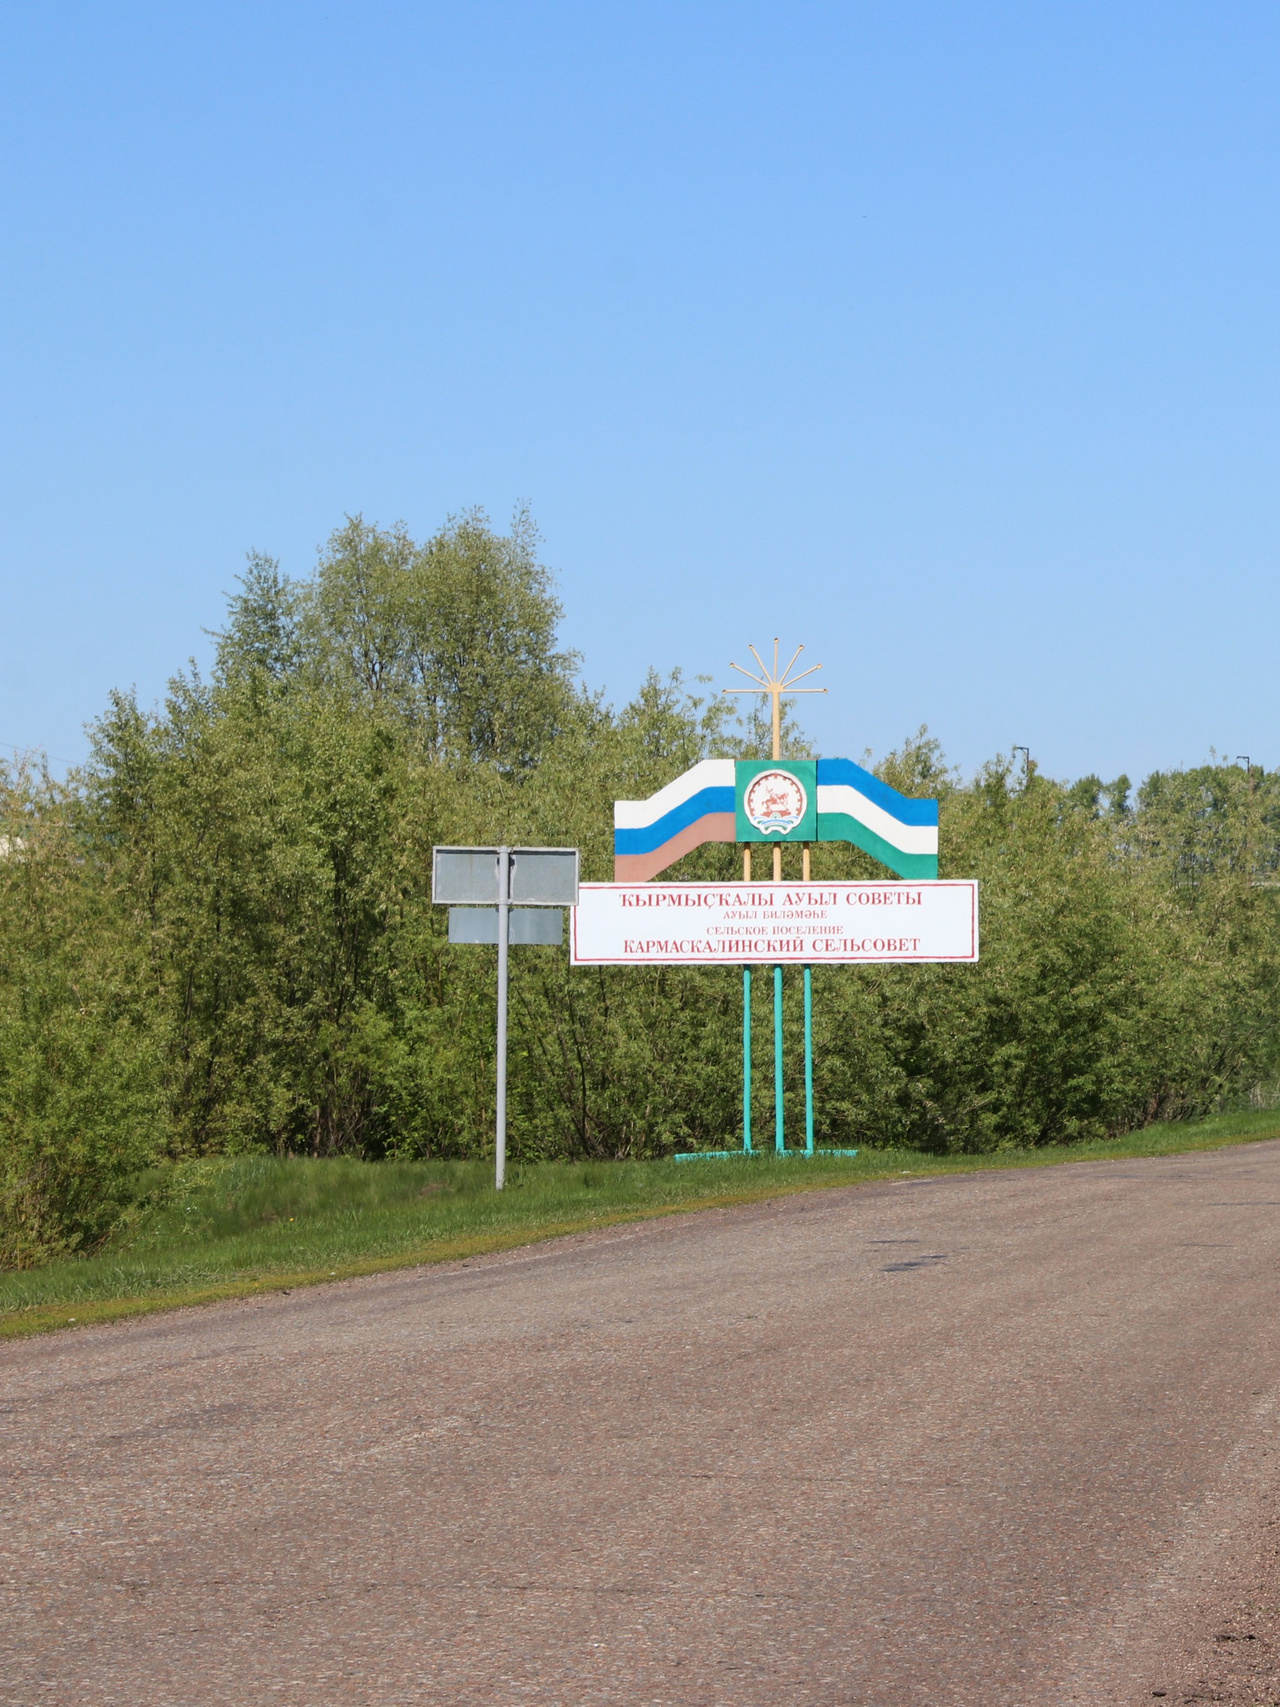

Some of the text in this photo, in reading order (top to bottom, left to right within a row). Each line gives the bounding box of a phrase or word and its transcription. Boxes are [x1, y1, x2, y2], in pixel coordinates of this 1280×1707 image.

[782, 892, 838, 907] АУЫЛ
[846, 891, 923, 906] СОВЕТЫ
[723, 910, 757, 920] АУЫЛ
[706, 925, 844, 936] СЕЛЬСКОЕ ПОСЕЛЕНИЕ
[623, 936, 921, 954] КАРМАСКАЛИНСКИЙ СЕЛЬСОВЕТ
